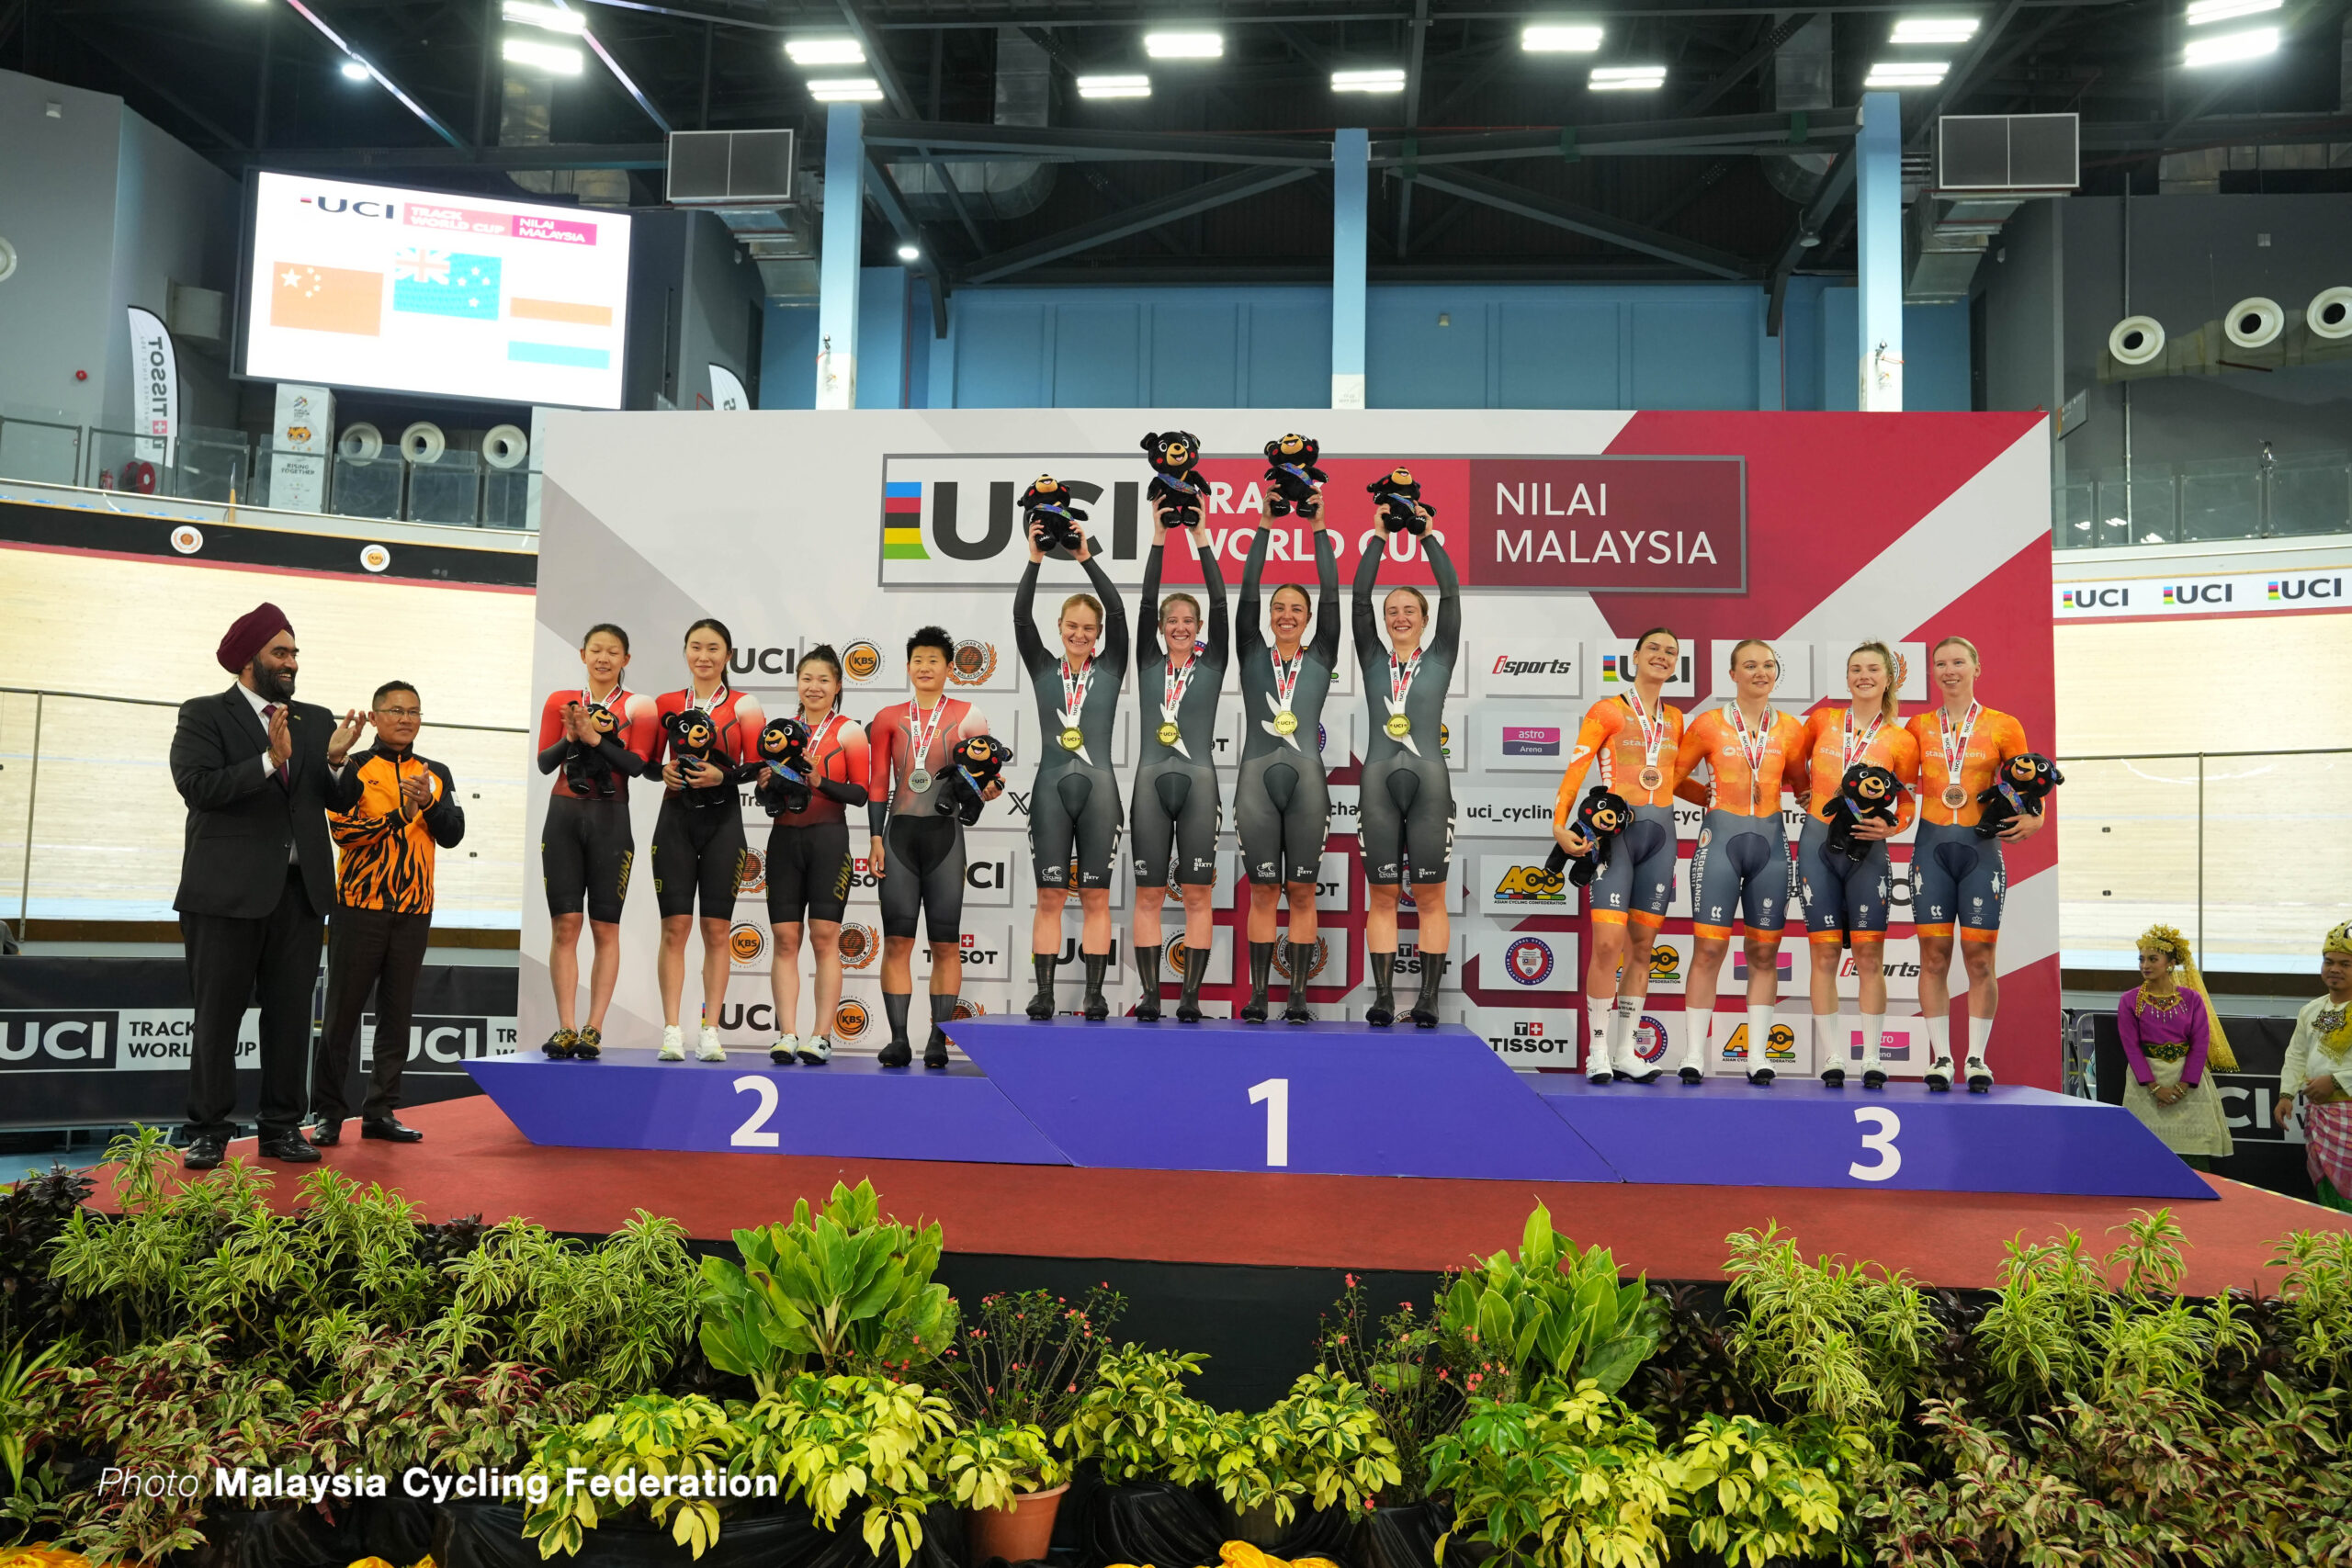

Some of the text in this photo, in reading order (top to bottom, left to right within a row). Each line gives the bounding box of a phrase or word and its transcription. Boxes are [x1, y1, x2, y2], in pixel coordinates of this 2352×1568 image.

[317, 196, 394, 220] UCI
[518, 217, 555, 231] NILAI
[518, 227, 586, 243] MALAYSIA
[1496, 482, 1607, 516] NILAI
[1496, 529, 1718, 565] MALAYSIA
[2075, 589, 2129, 608] UCI
[2177, 583, 2232, 604] UCI
[2281, 578, 2342, 599] UCI
[729, 648, 796, 675] UCI
[854, 657, 874, 667] KBS
[1518, 729, 1545, 739] astro
[1467, 804, 1555, 823] uci_cyclin
[616, 850, 633, 900] CHINA
[832, 852, 853, 901] CHINA
[967, 862, 1005, 888] CI
[1693, 848, 1709, 913] NEDERLANDSE
[738, 939, 758, 949] KBS
[922, 950, 998, 964] TSOT
[842, 1015, 863, 1026] KBS
[129, 1042, 192, 1057] WORL
[1488, 1038, 1568, 1058] TISSOT
[730, 1075, 779, 1147] 2
[2217, 1086, 2272, 1129] CI
[1247, 1078, 1288, 1167] 1
[1848, 1106, 1902, 1181] 3
